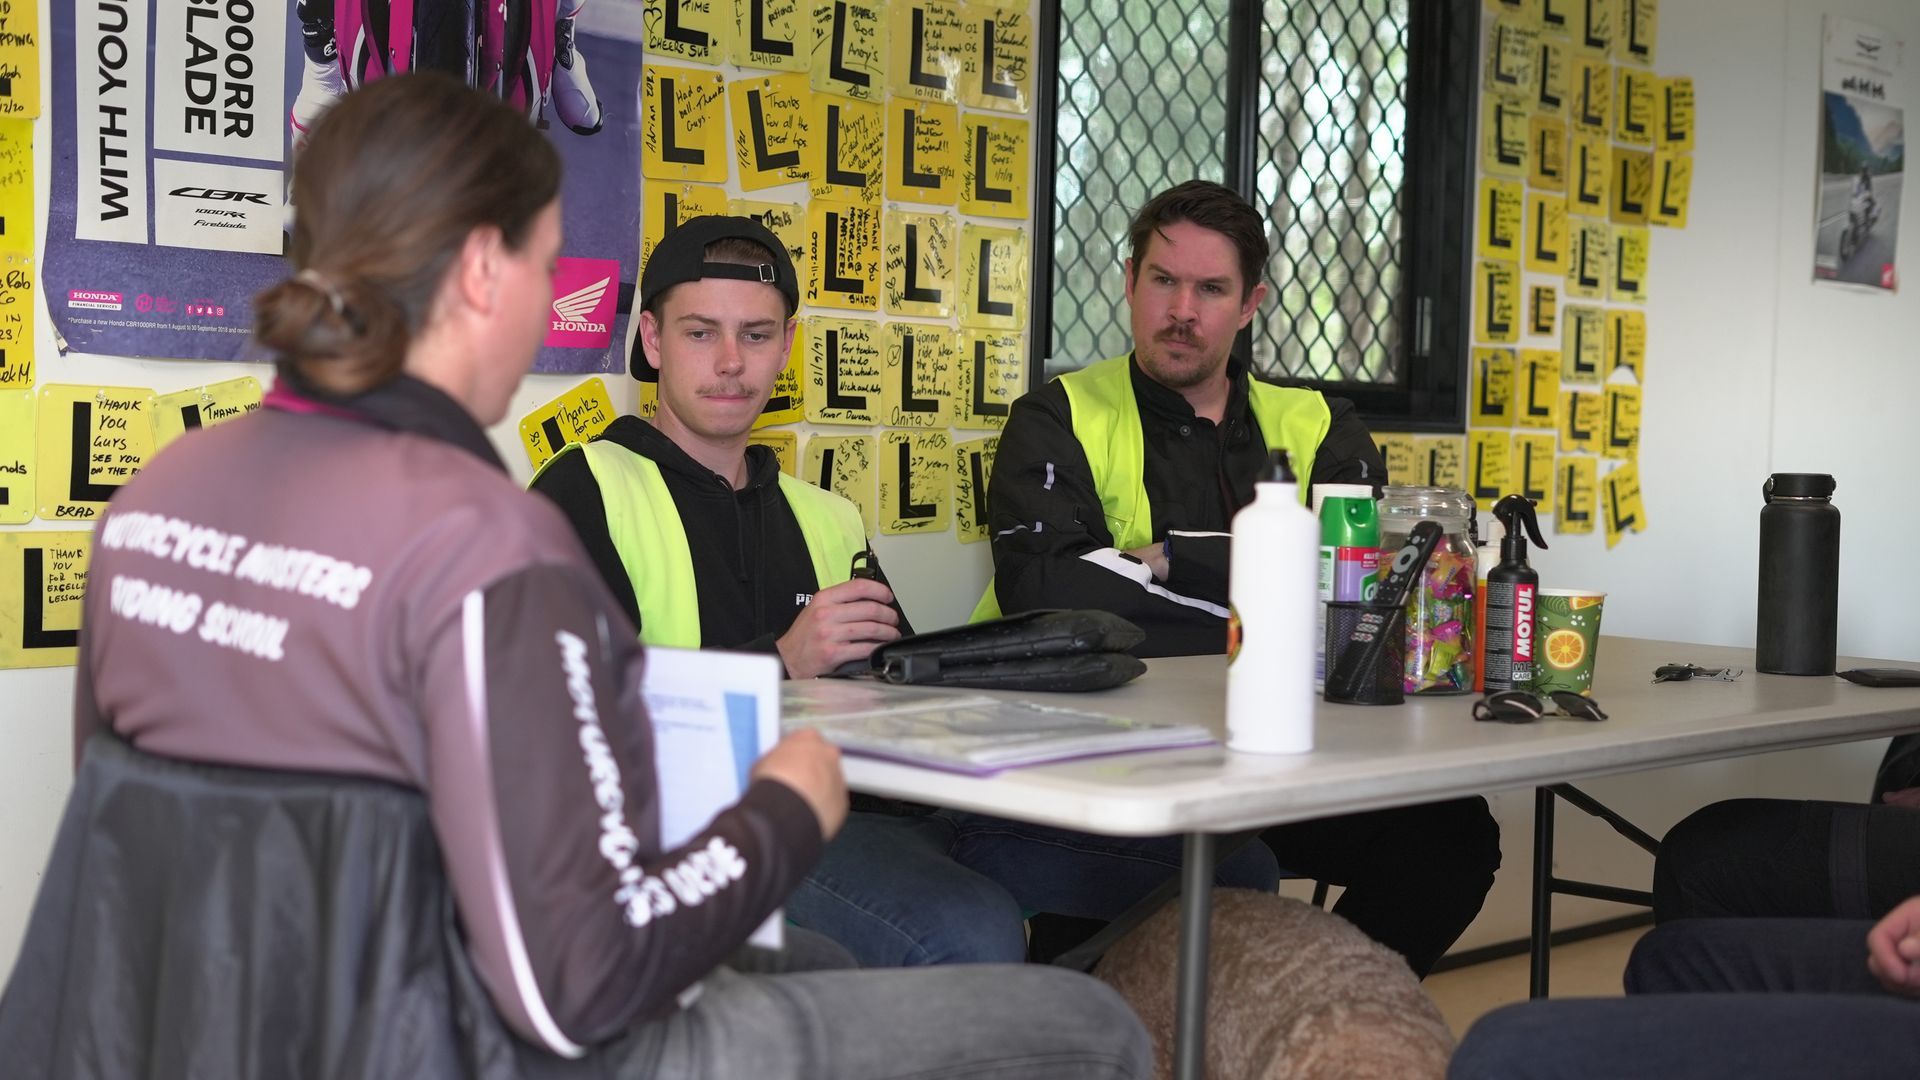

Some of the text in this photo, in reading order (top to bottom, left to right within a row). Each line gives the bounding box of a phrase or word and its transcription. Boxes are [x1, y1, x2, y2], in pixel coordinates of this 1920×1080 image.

[682, 2, 709, 13] TIME
[688, 45, 709, 57] SUE
[830, 1, 870, 88] L
[910, 8, 947, 90] L
[185, 0, 218, 135] LADE
[982, 20, 1018, 99] L
[676, 85, 703, 104] Had a
[765, 91, 800, 110] Thanks
[98, 0, 129, 222] WITH YOU
[646, 104, 656, 153] Adrian
[661, 78, 705, 165] L
[765, 114, 778, 128] for
[783, 115, 793, 128] all
[748, 90, 800, 172] L
[827, 105, 867, 188] L
[903, 109, 941, 189] L
[975, 126, 1012, 203] L
[168, 187, 273, 206] CBR
[679, 200, 703, 212] Thanks
[196, 208, 247, 220] 1000RR
[194, 219, 247, 230] Fireblade
[824, 212, 864, 294] L
[902, 225, 940, 303] L
[978, 239, 1013, 316] L
[72, 291, 119, 302] HONDA
[108, 320, 125, 328] Honda
[126, 321, 156, 329] CBR1000RR
[172, 324, 186, 332] August
[197, 325, 218, 333] September
[552, 321, 607, 333] HONDA
[840, 327, 870, 343] Thanks
[786, 370, 795, 381] all
[827, 330, 867, 410] L
[902, 335, 939, 413] L
[839, 380, 855, 391] Nick
[97, 400, 141, 411] THANK
[203, 401, 261, 419] THANK YOU
[556, 397, 599, 425] Thanks
[100, 415, 126, 430] YOU
[573, 409, 605, 437] for all
[93, 436, 127, 450] GUYS
[92, 454, 140, 464] SEE YOU
[91, 467, 127, 475] ON THE
[899, 440, 937, 520] L
[56, 505, 95, 518] BRAD
[50, 549, 83, 559] THANK
[53, 562, 72, 571] YOU
[49, 573, 65, 584] FOR
[1517, 588, 1533, 657] MOTUL
